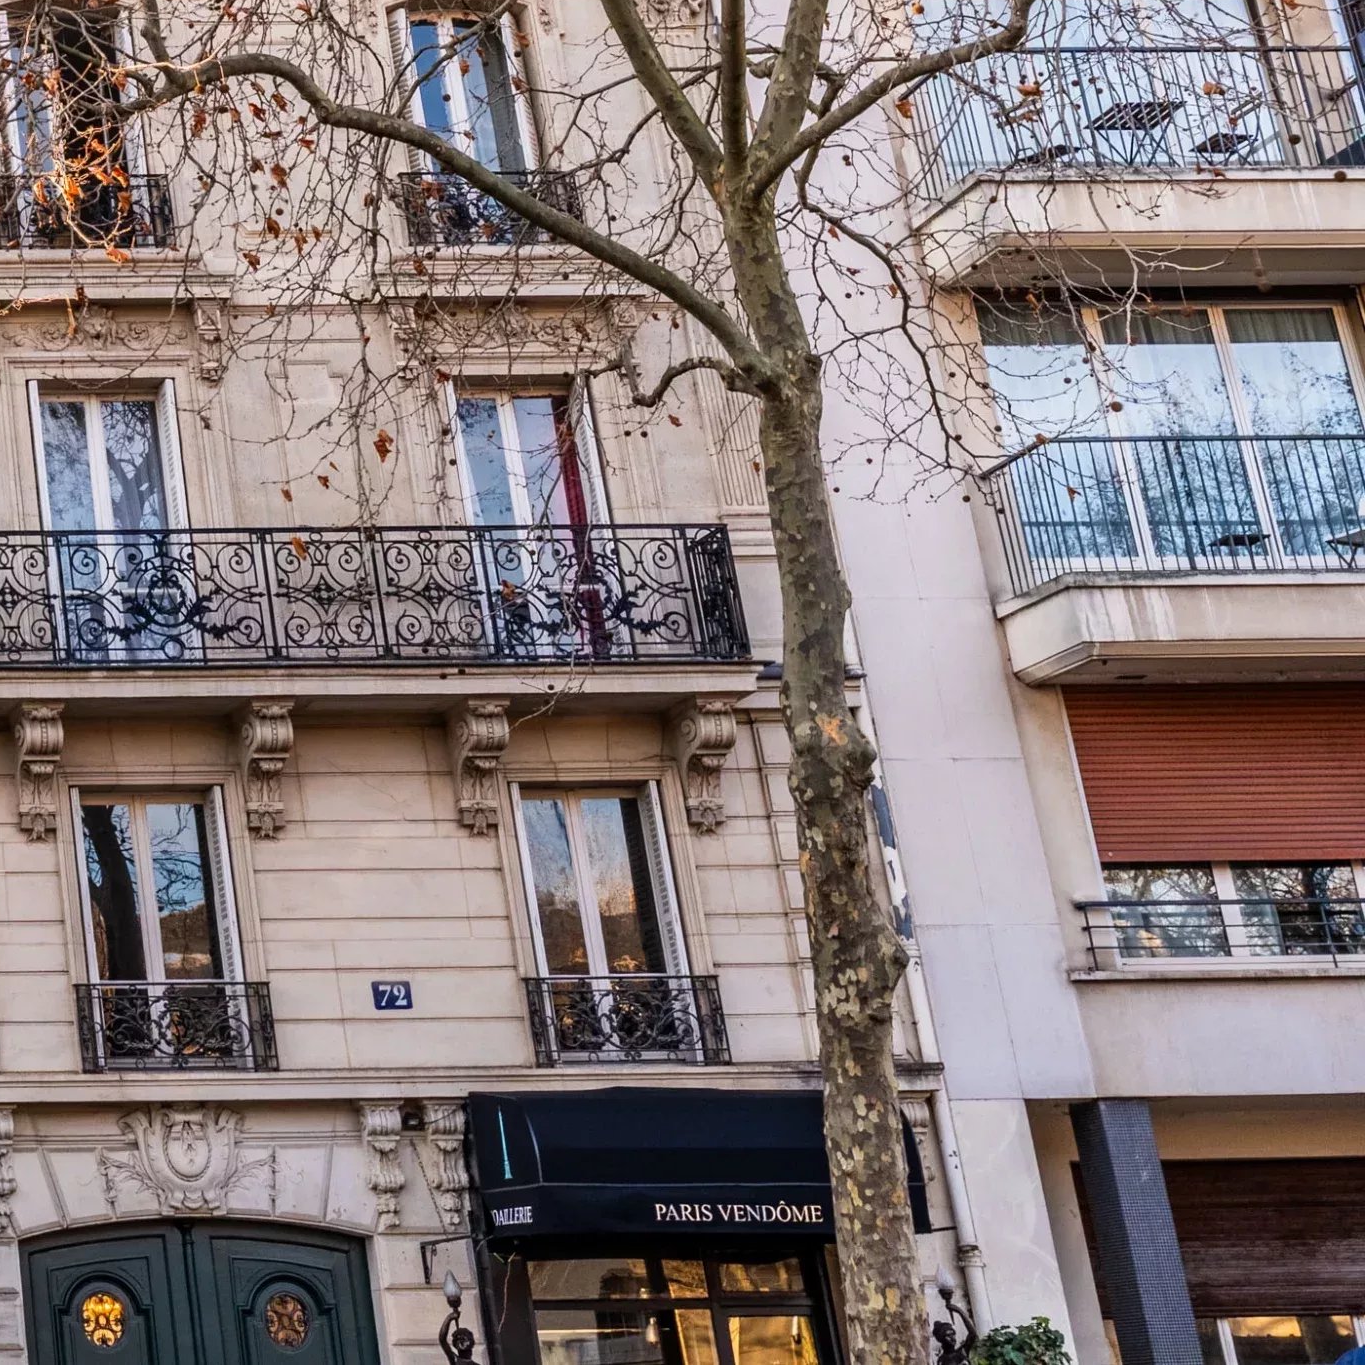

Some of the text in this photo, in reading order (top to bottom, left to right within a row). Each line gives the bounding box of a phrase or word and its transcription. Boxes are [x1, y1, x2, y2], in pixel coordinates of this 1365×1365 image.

[379, 985, 408, 1006] 72
[490, 1206, 533, 1226] OAILLERIE
[655, 1200, 824, 1223] PARIS VENDÔME
